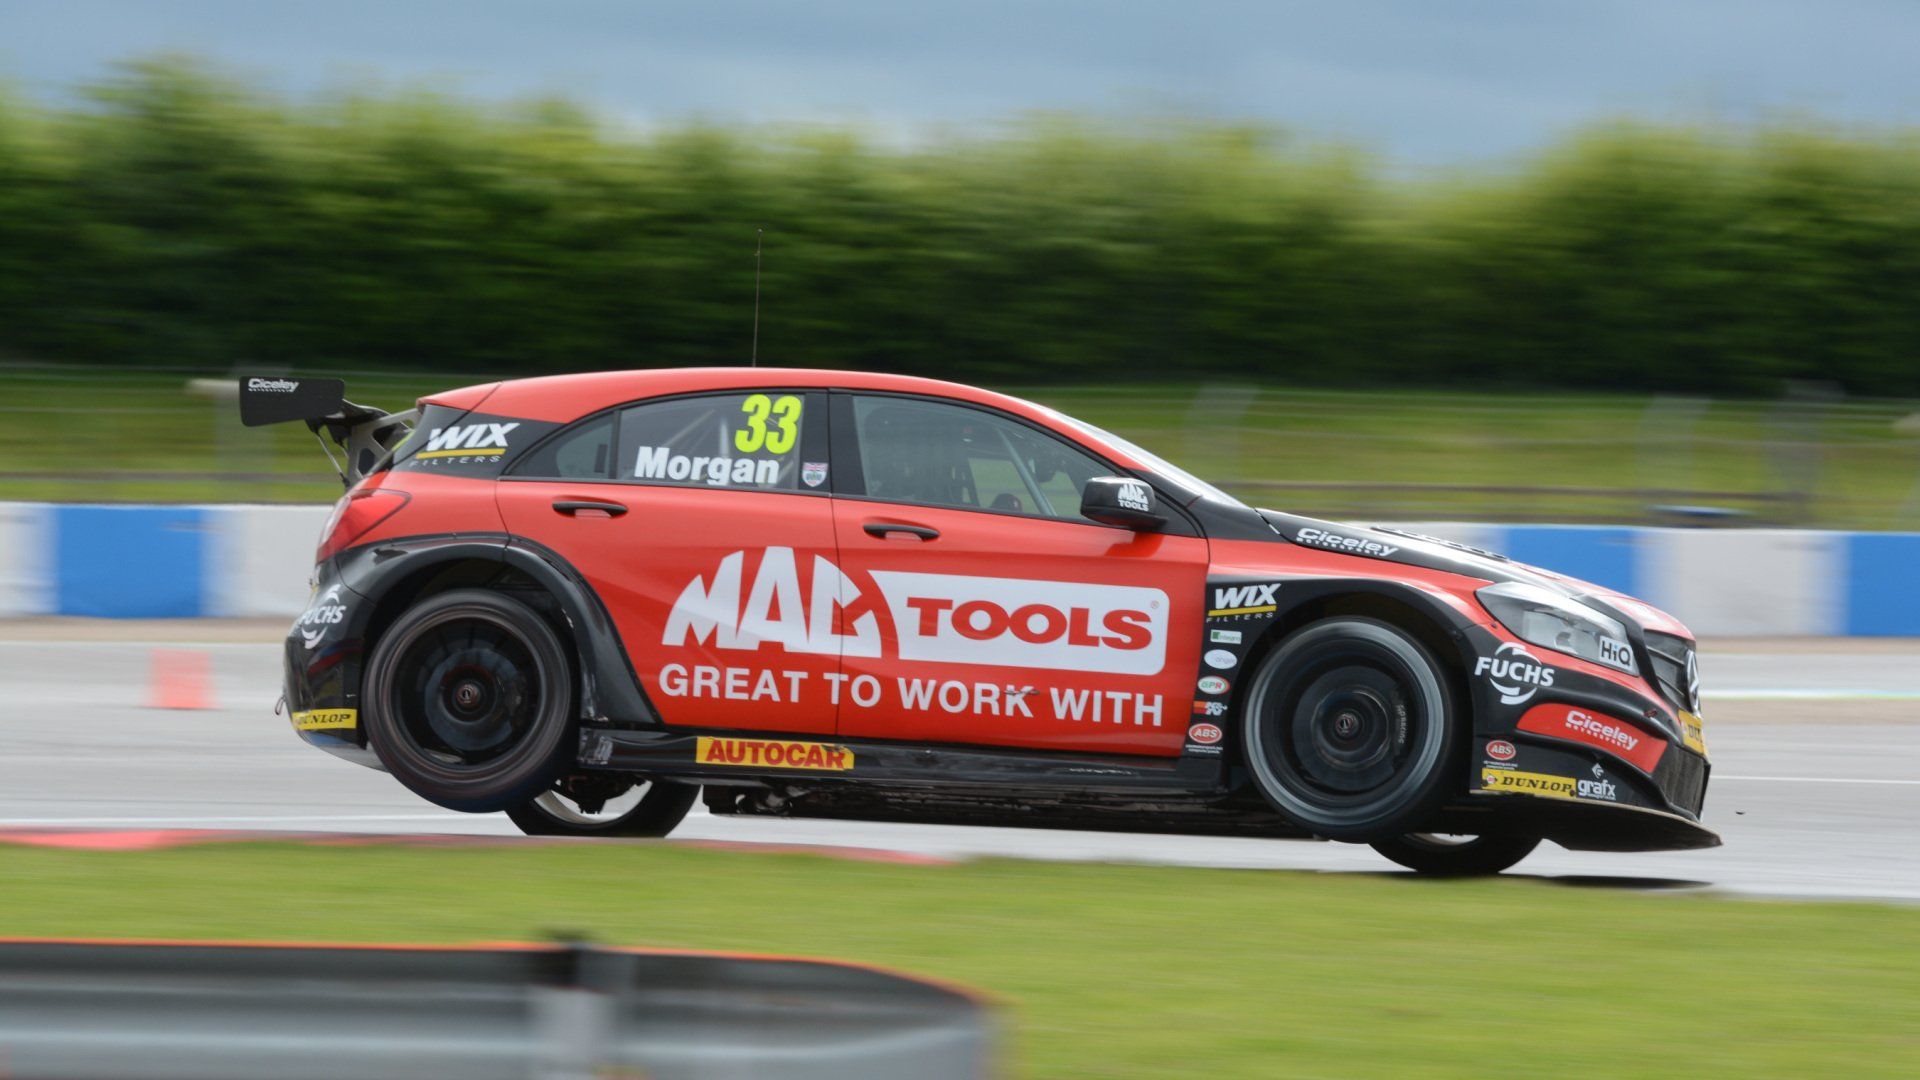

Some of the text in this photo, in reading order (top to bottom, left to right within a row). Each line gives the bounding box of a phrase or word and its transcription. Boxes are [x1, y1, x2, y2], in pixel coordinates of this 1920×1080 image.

[427, 423, 519, 451] WIX
[735, 394, 801, 454] 33
[408, 455, 501, 467] FILTERS
[634, 446, 779, 486] Morgan
[1119, 500, 1149, 512] TOOLS
[1297, 528, 1399, 557] Ciceley
[662, 546, 1152, 658] MAC TOOLS
[1215, 583, 1281, 610] WIX
[1206, 612, 1274, 623] FILTERS
[1601, 641, 1631, 667] HiQ
[1474, 656, 1555, 687] FUCHS
[659, 663, 1163, 726] GREAT TO WORK WITH
[1194, 727, 1218, 738] ABS
[1566, 711, 1639, 750] Ciceley
[705, 739, 846, 769] AUTOCAR
[1490, 744, 1513, 755] ABS
[1502, 776, 1572, 792] DUNLOP
[1578, 779, 1616, 797] grafx
